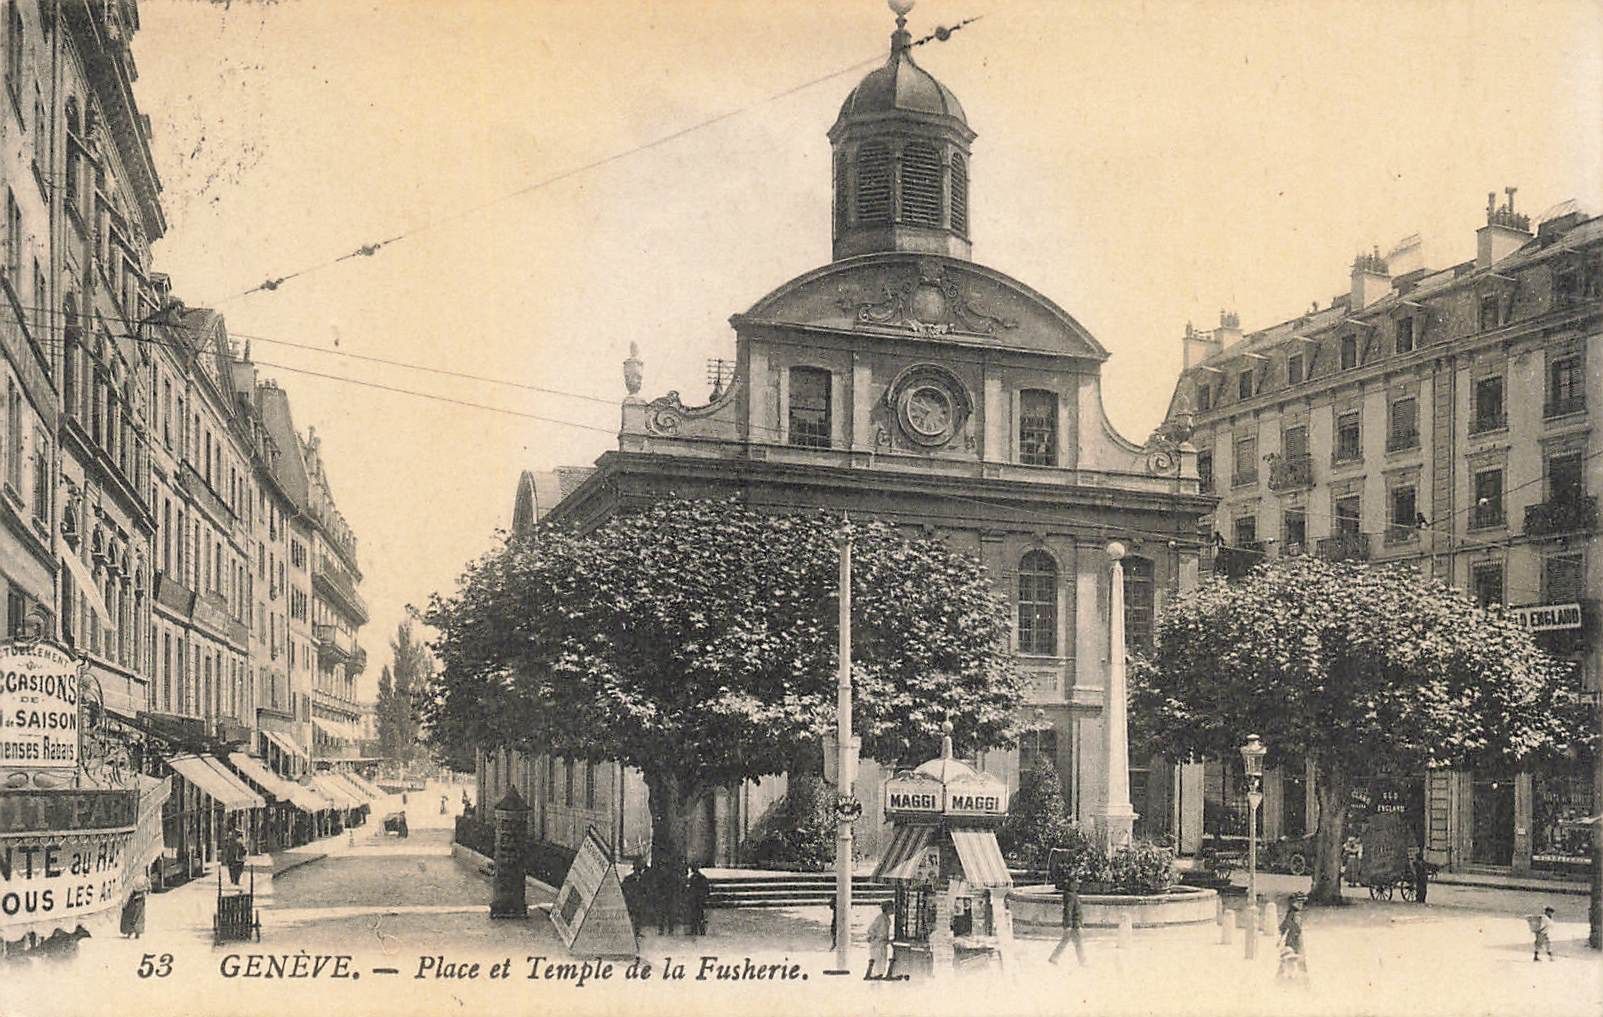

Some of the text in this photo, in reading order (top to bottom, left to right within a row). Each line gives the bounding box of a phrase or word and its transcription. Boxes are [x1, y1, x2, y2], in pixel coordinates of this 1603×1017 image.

[1530, 607, 1580, 628] ENGLAND
[20, 695, 40, 704] DE
[15, 709, 77, 731] SAISON
[43, 735, 74, 761] Rabais
[890, 794, 936, 809] MAGGI
[951, 796, 1000, 811] MAGGI
[71, 852, 92, 876] au
[66, 884, 94, 908] LES
